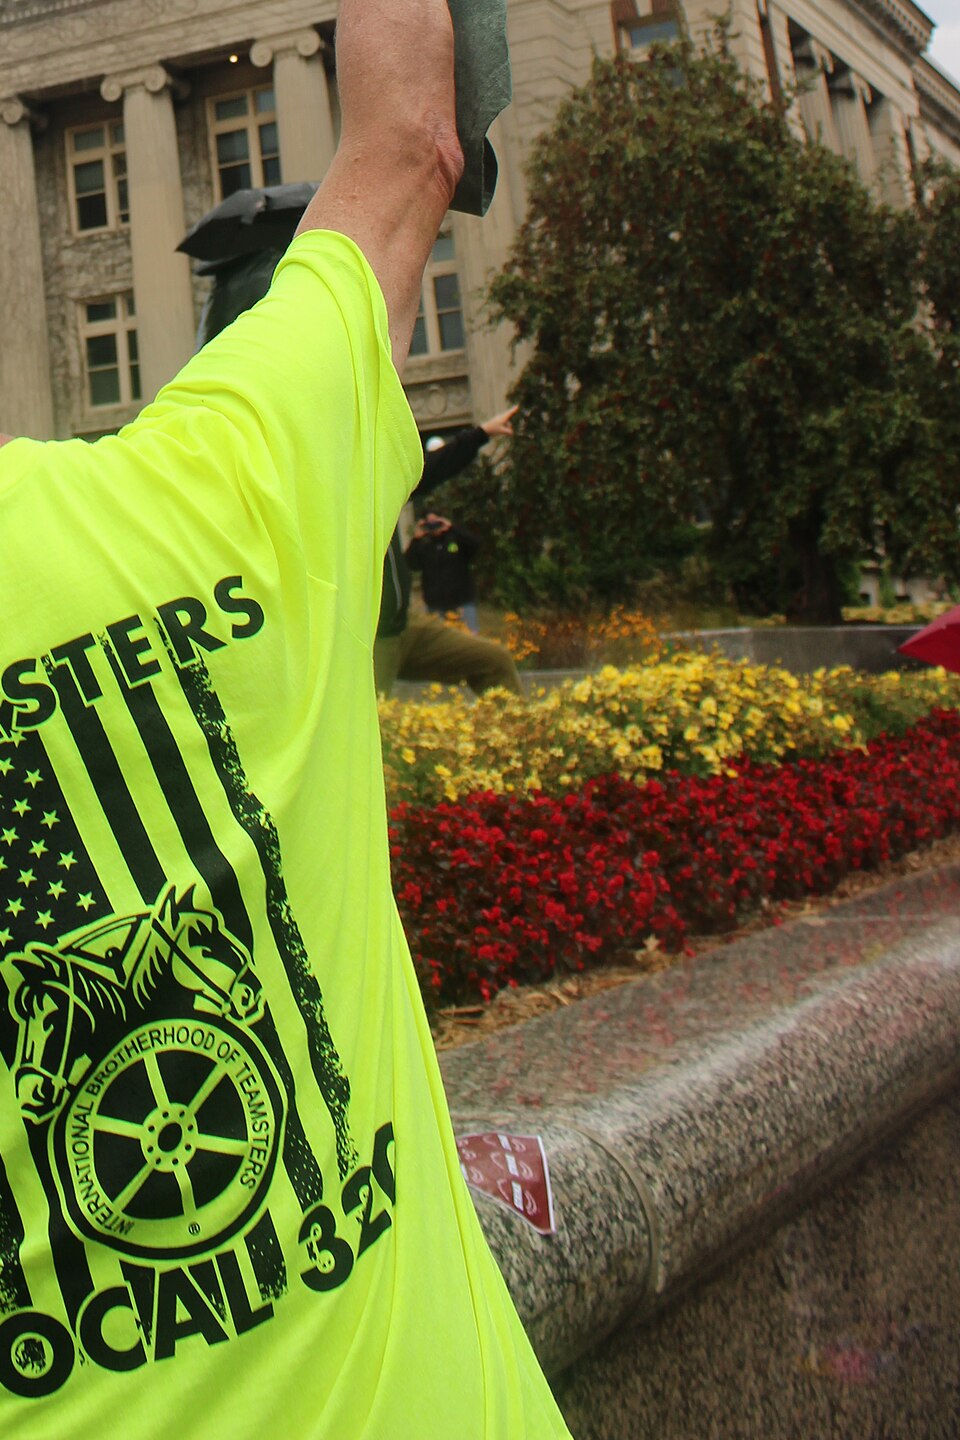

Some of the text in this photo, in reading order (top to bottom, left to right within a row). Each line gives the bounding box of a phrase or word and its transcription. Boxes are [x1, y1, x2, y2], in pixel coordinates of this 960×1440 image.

[69, 1026, 271, 1237] INTERNATIONAL BROTHERHOOD OF TEAMSTERS
